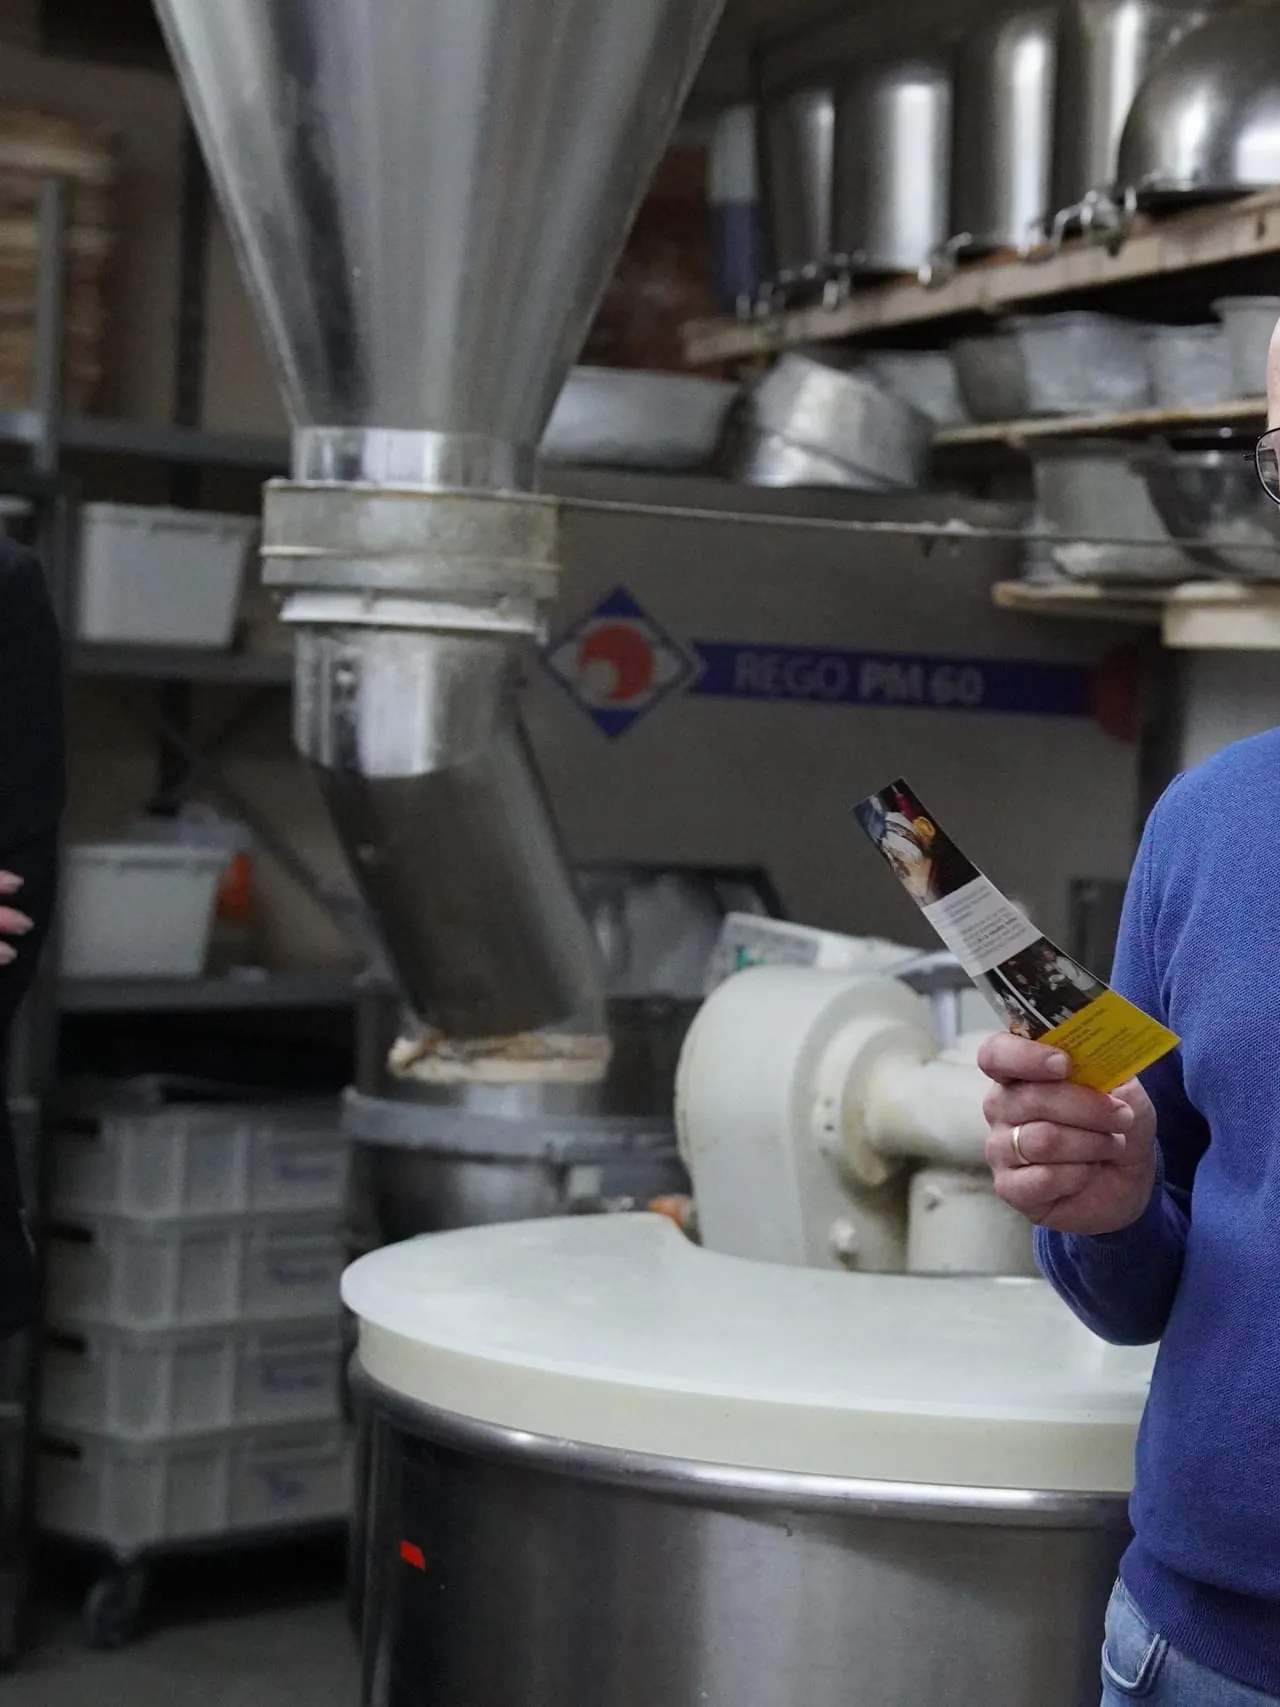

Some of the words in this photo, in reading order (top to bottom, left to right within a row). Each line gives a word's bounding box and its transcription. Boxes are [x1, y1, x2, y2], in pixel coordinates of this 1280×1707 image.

[734, 651, 852, 697] REGO
[859, 660, 926, 703] PM
[929, 664, 985, 708] 60
